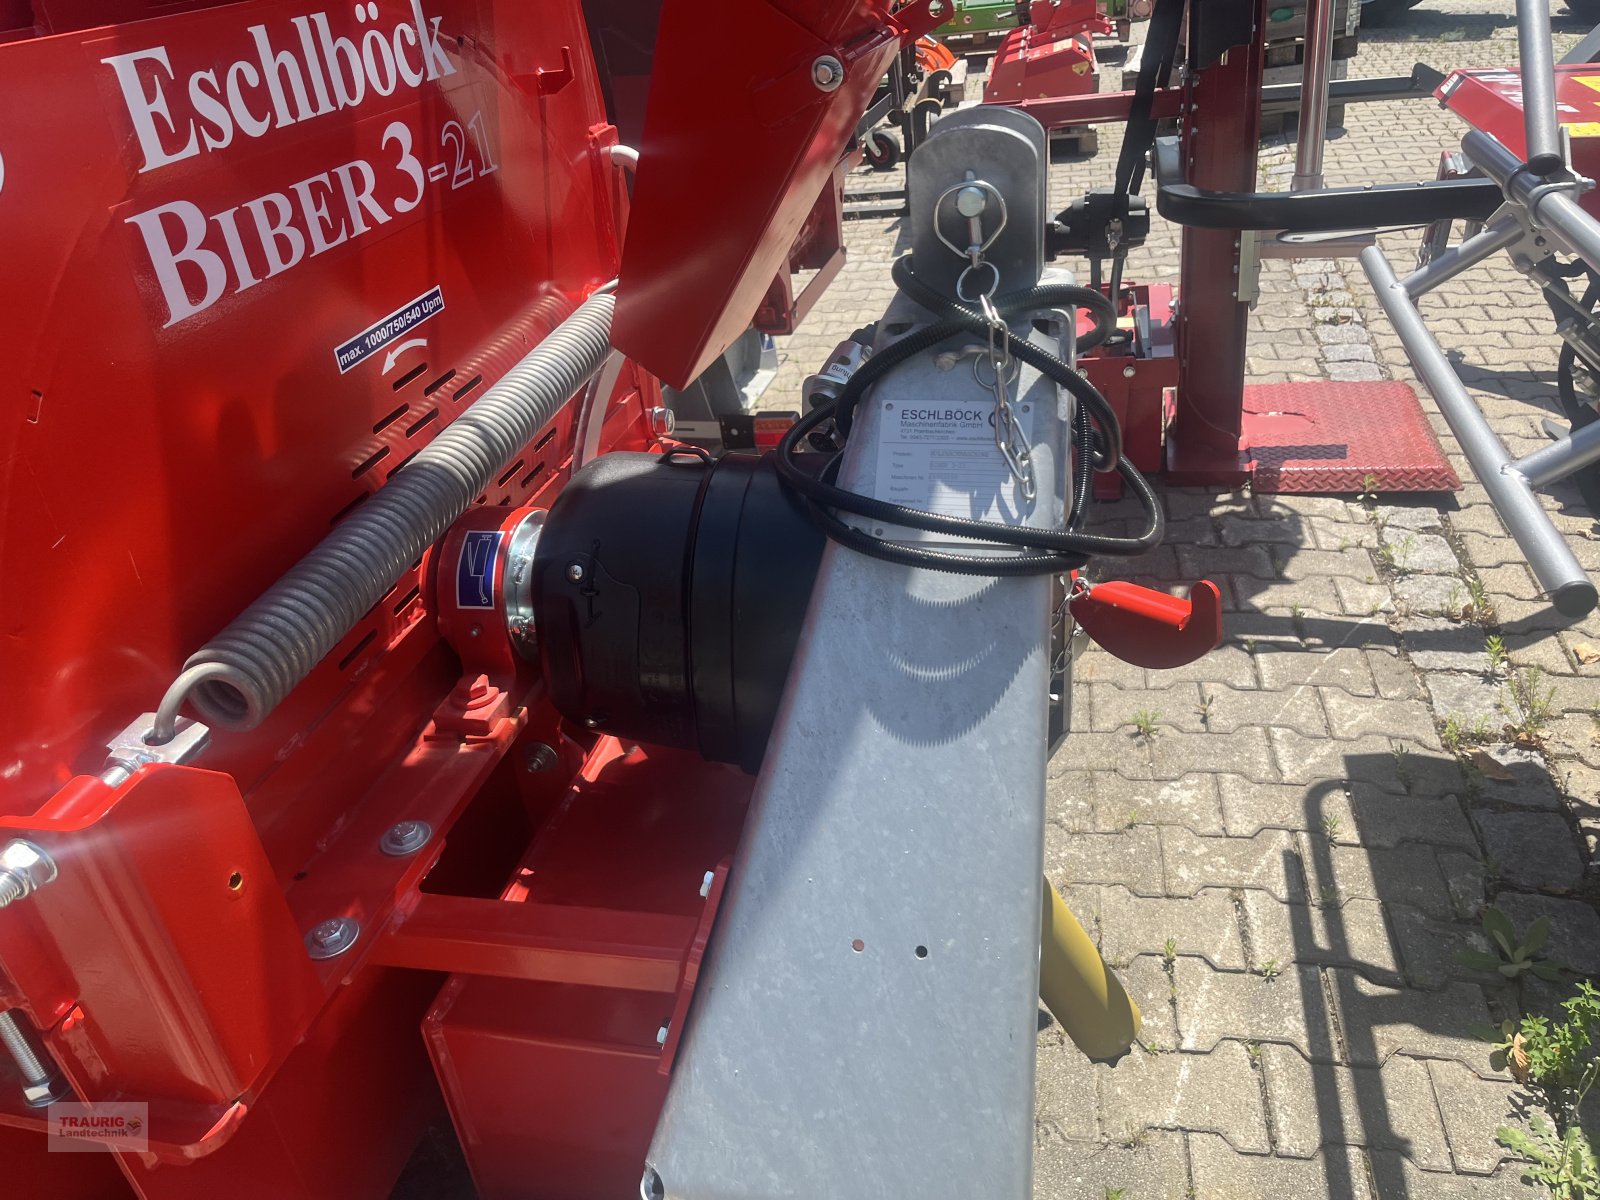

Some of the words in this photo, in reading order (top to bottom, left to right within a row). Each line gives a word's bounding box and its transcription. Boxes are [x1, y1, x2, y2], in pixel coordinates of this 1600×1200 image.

[101, 0, 457, 173] Eschlböck
[125, 160, 392, 328] BIBER
[381, 110, 498, 213] 3-21
[340, 346, 364, 365] max.
[365, 306, 421, 349] 1000/750/540
[421, 295, 442, 313] Upm
[901, 409, 982, 421] ESCHLBÖCK
[901, 420, 959, 429] Maschinenfabrik
[959, 421, 983, 429] GmbH
